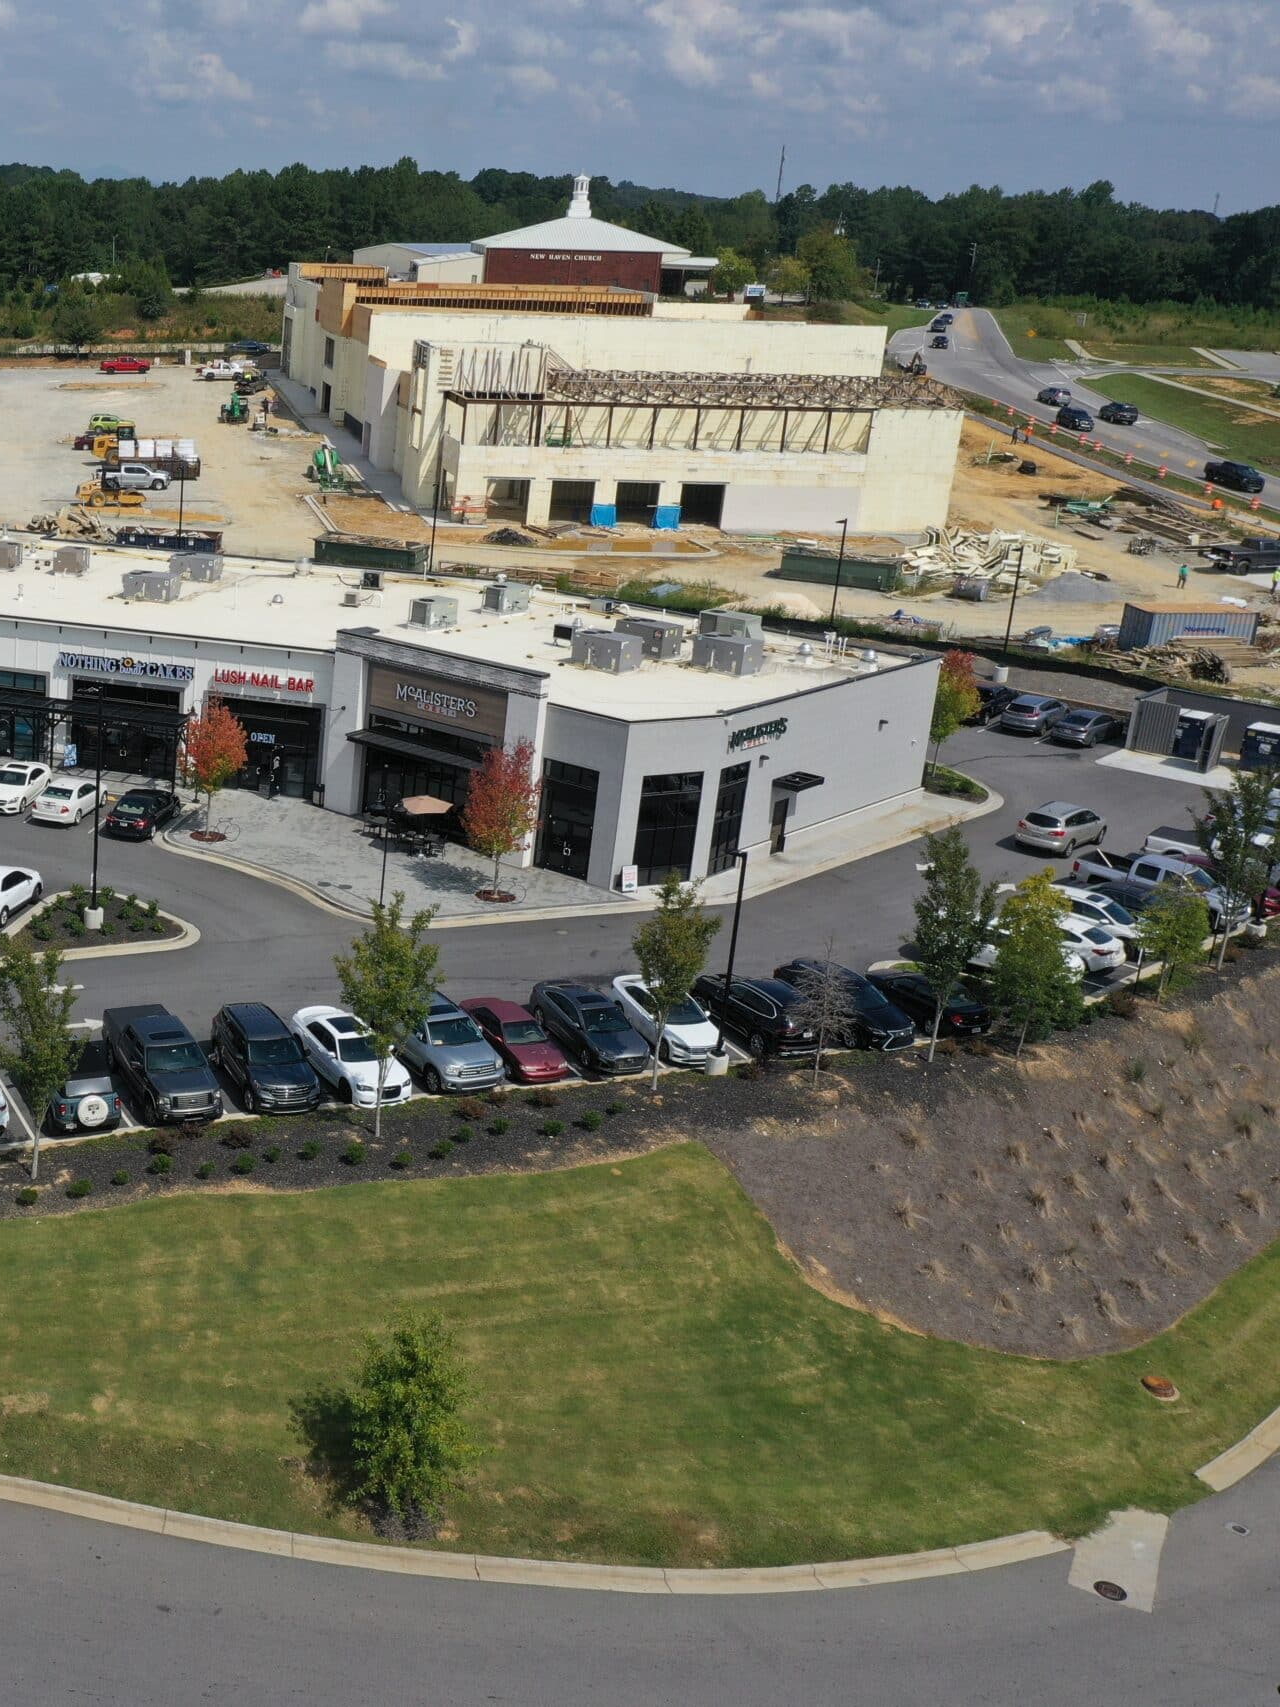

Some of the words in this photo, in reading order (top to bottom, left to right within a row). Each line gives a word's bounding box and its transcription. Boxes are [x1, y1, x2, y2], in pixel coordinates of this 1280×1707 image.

[574, 254, 602, 262] CHURCH
[58, 651, 116, 673] NOTHING
[146, 662, 194, 681] CAKES
[214, 668, 247, 685] LUSH
[251, 672, 282, 689] NAIL
[287, 676, 315, 693] BAR
[250, 732, 276, 744] OPEN
